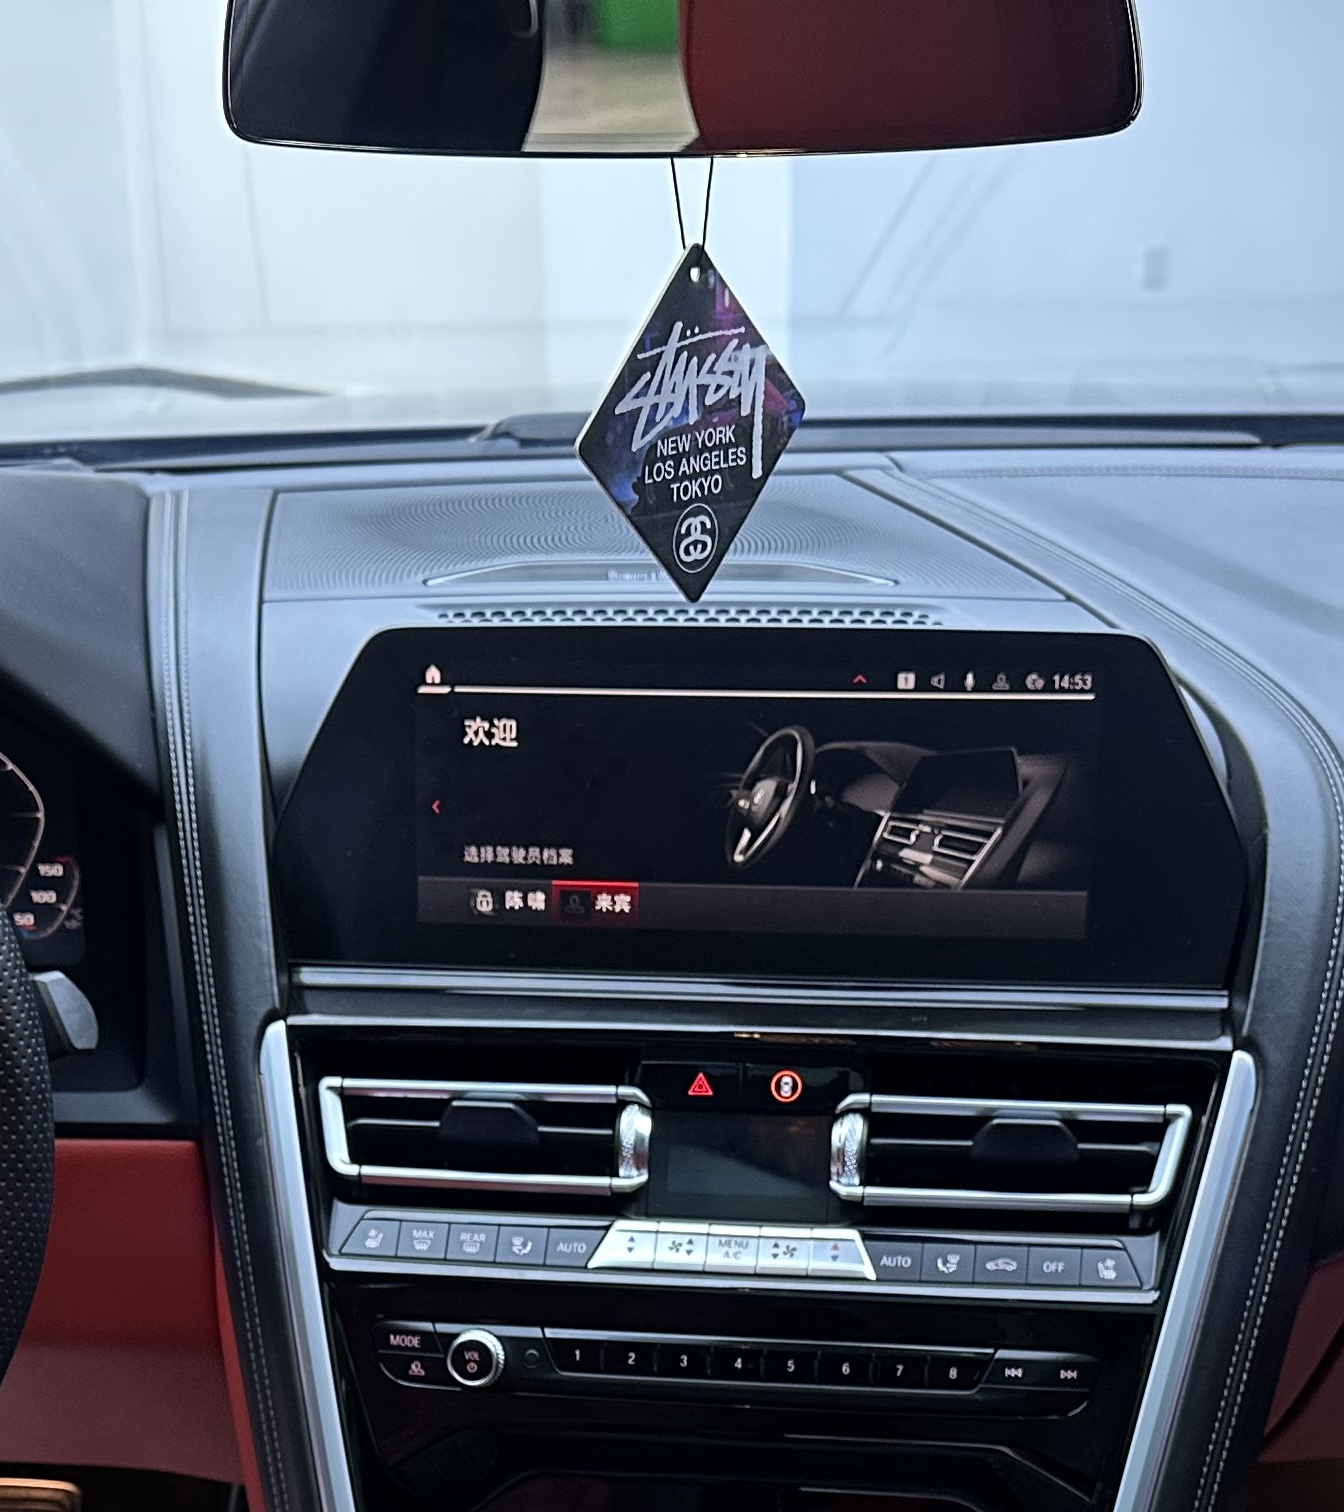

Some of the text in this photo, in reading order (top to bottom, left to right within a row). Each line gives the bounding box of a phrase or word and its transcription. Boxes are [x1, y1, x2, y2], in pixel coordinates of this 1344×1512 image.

[656, 424, 735, 458] NEW YORK
[644, 446, 747, 484] LOS ANGELES
[670, 474, 722, 502] TOKYO
[1052, 672, 1093, 690] 14:53
[462, 715, 518, 747] 欢迎
[463, 845, 574, 865] 选择驾驶员档案
[412, 1229, 435, 1240] MAX
[460, 1232, 486, 1244] REAR
[556, 1241, 587, 1254] AUTO
[718, 1239, 749, 1250] MENU
[880, 1254, 912, 1269] AUTO
[1043, 1260, 1065, 1274] OFF
[389, 1334, 421, 1348] MODE
[464, 1350, 480, 1362] VOL
[575, 1349, 958, 1380] 1 2 3 4 5 6 7 8
